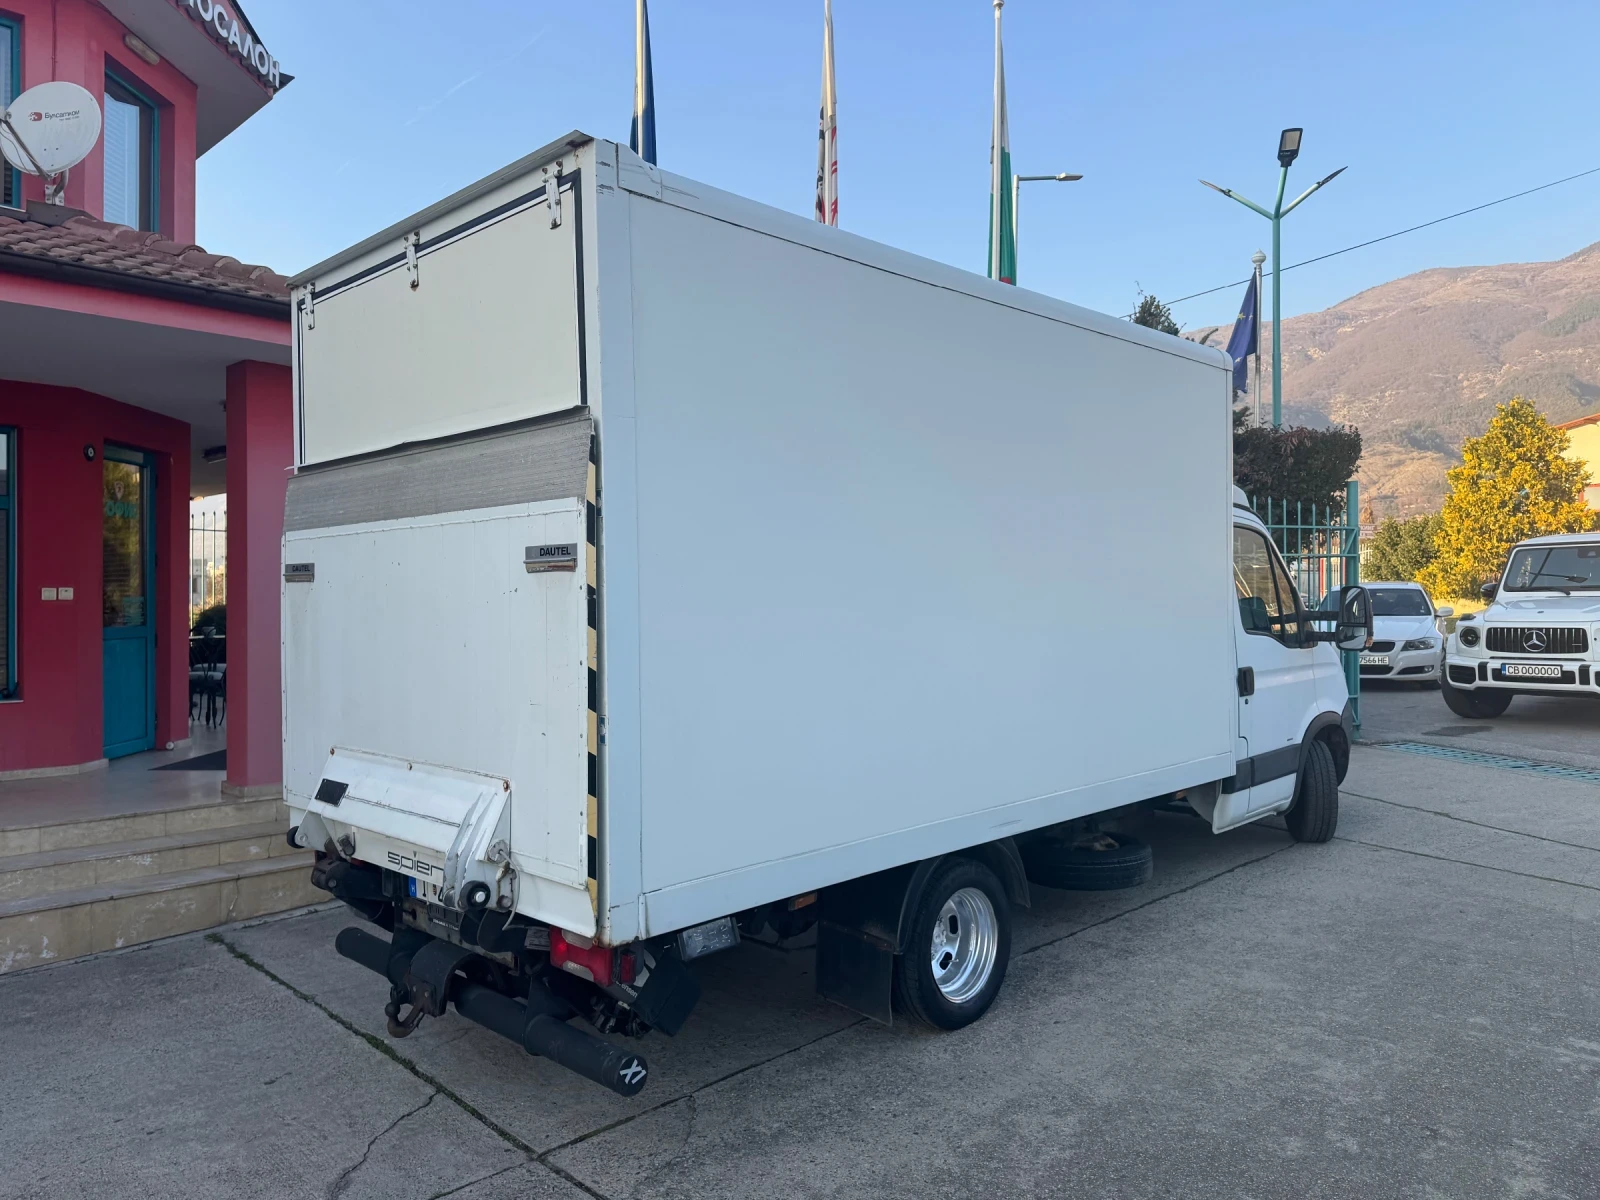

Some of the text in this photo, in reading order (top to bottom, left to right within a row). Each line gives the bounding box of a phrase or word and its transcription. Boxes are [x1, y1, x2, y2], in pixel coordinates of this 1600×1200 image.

[540, 546, 571, 556] DAUTEL
[1507, 665, 1560, 676] CB 000000
